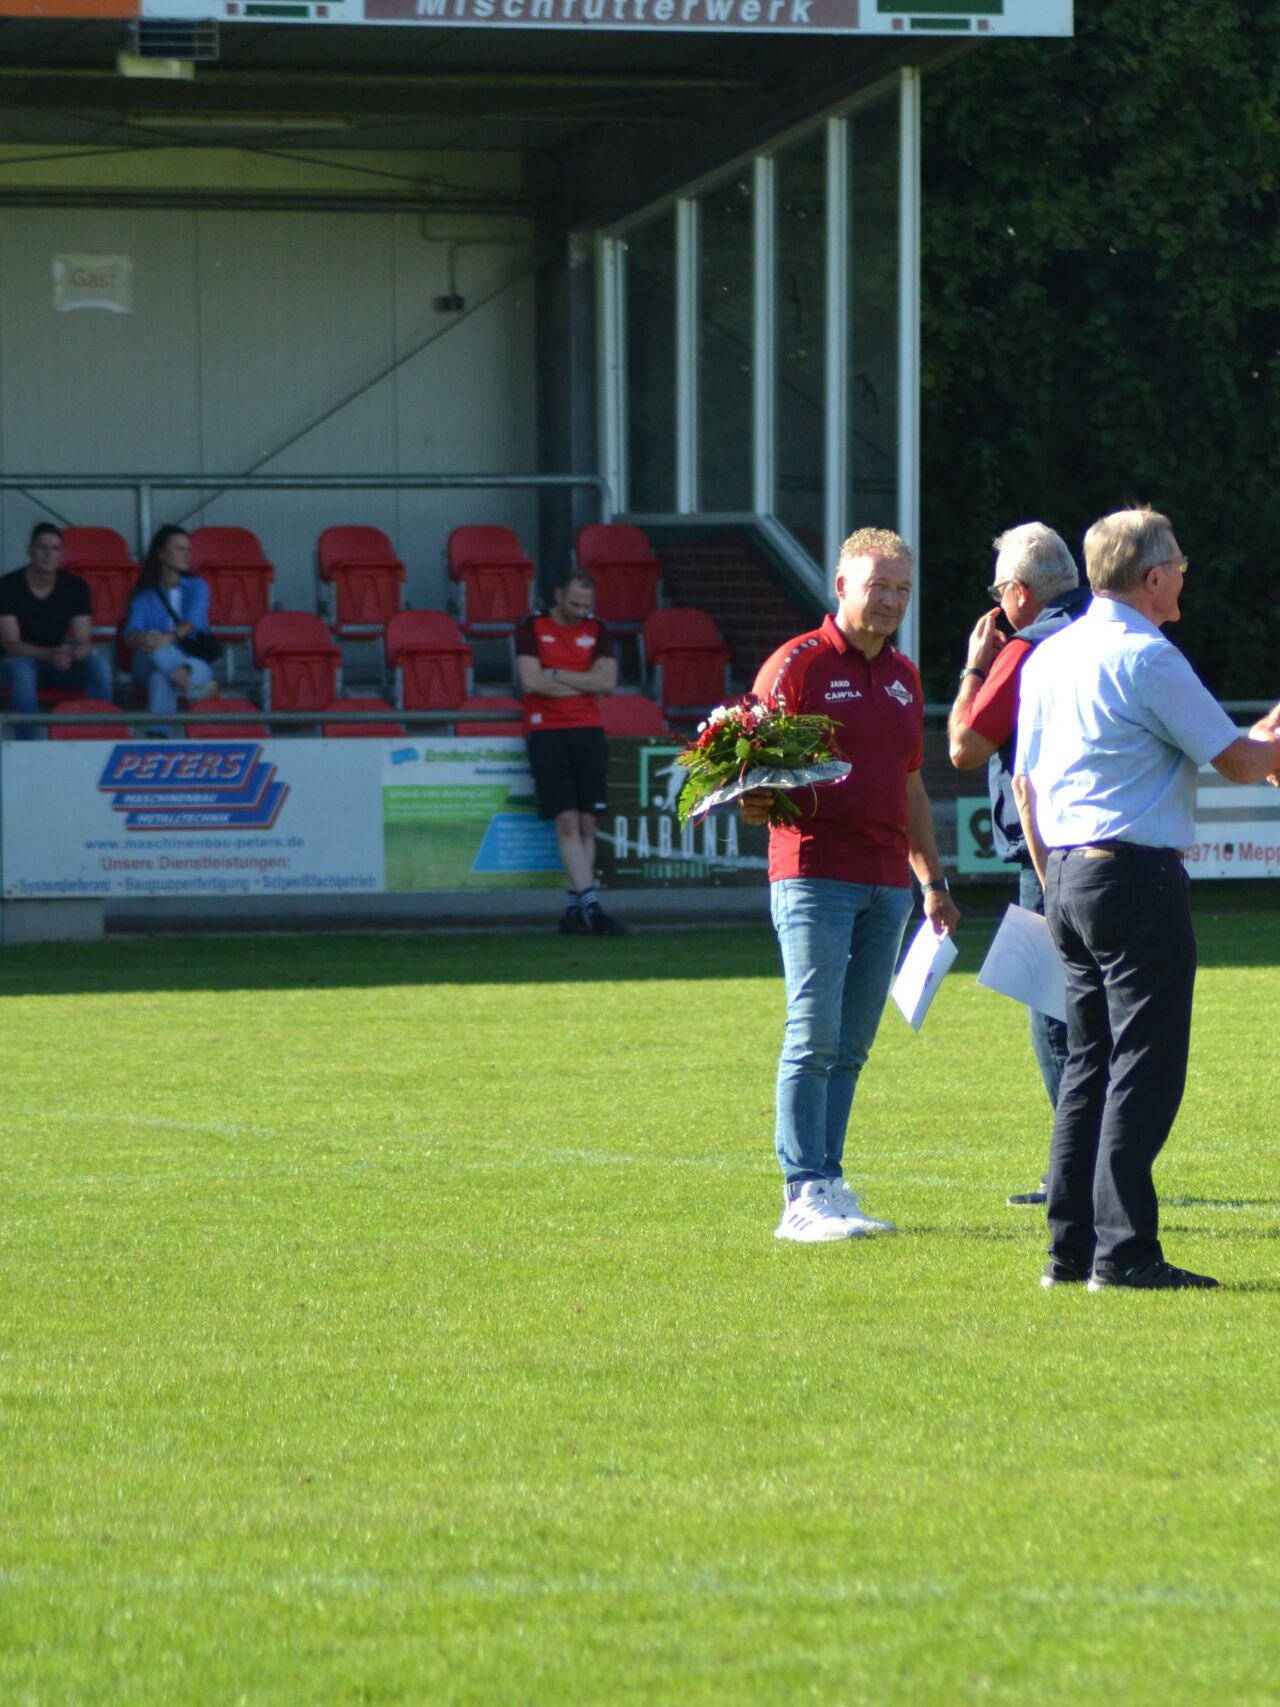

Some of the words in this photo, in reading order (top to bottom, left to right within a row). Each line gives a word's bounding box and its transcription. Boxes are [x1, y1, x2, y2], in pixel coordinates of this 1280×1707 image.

[830, 680, 850, 688] JAKO
[824, 691, 862, 700] CAWILA
[113, 752, 246, 779] PETERS
[124, 793, 218, 804] MASCHINENBAU
[138, 813, 231, 823] METALLTECHNIK
[85, 837, 305, 850] www.maschinenbau-peters.de
[101, 857, 154, 871] Unsere
[160, 855, 291, 873] Dienstleistungen:
[19, 878, 112, 894] Systemlieferant
[125, 876, 250, 893] Baugruppenfertigung
[262, 874, 376, 890] Schweißfachbetrieb
